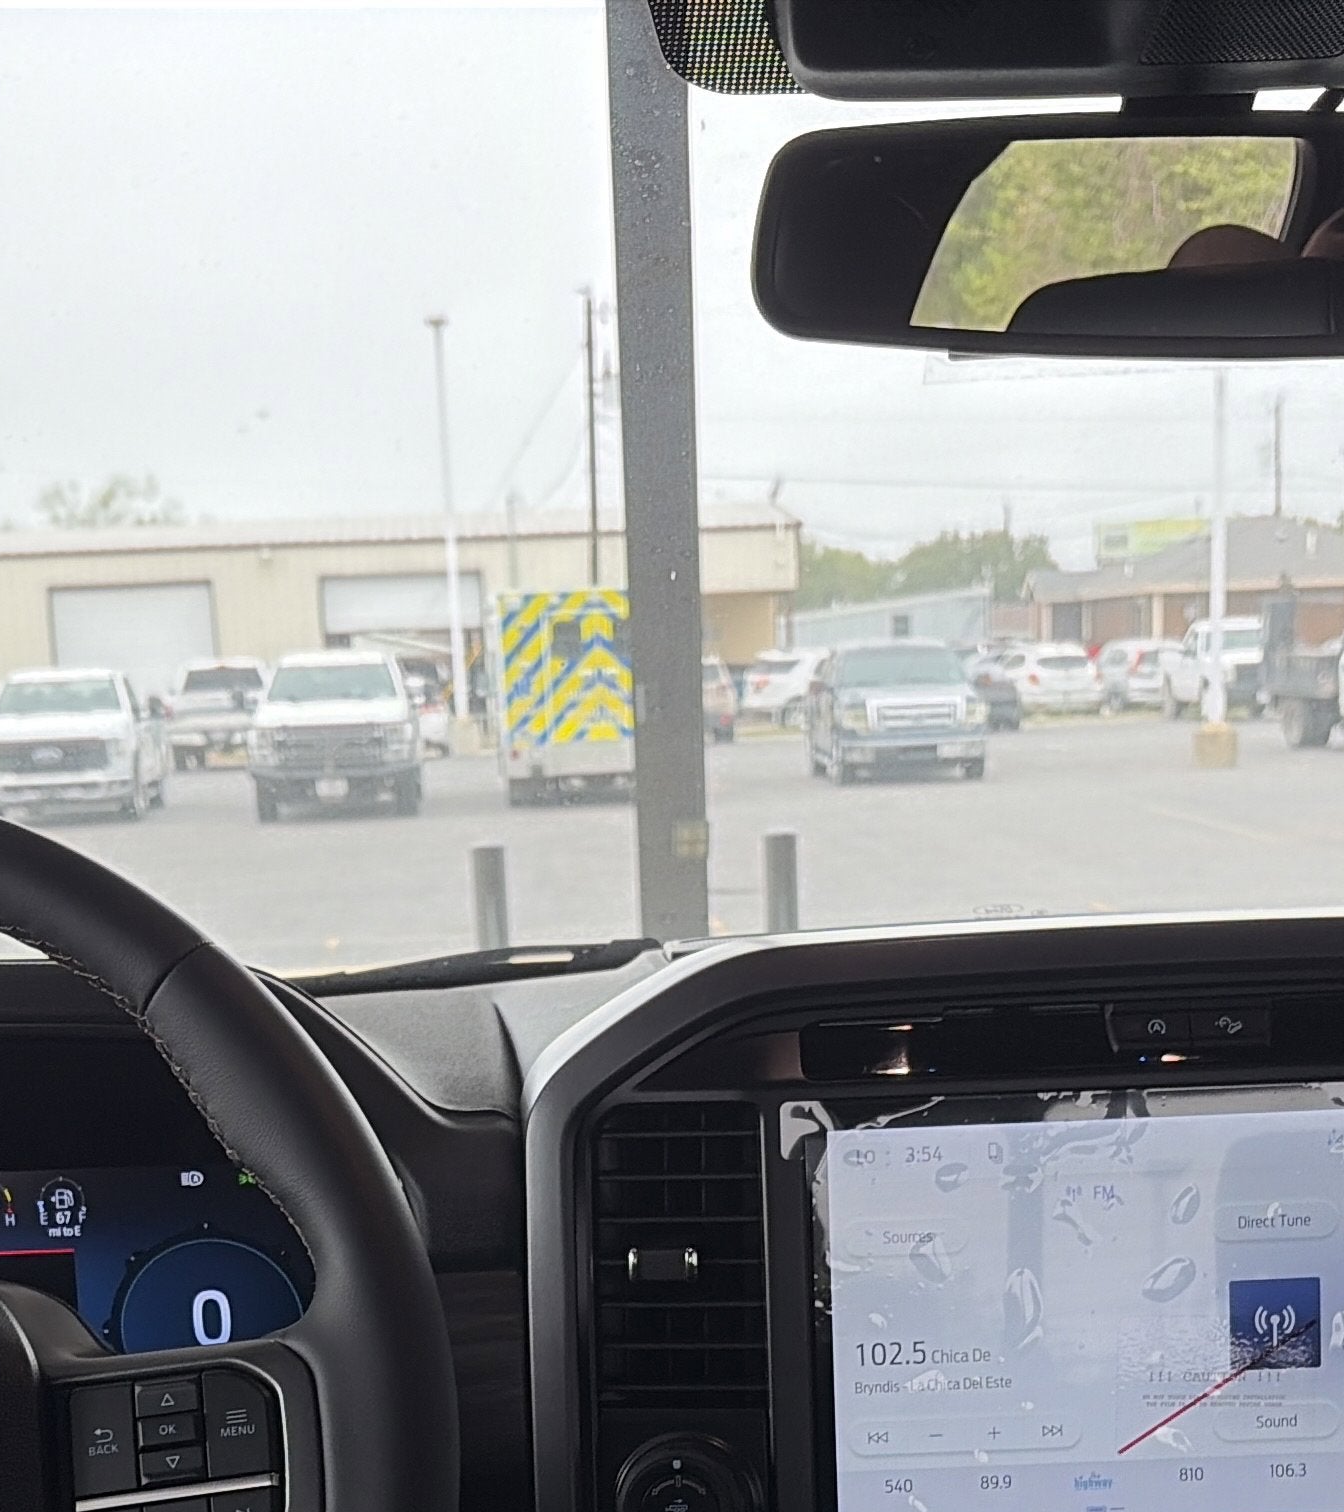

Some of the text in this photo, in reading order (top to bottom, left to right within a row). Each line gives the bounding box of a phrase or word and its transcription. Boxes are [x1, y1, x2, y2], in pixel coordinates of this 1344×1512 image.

[905, 1146, 944, 1163] 3:54
[1093, 1185, 1115, 1199] FM
[56, 1211, 71, 1225] 67
[1238, 1213, 1311, 1229] Direct Tune
[882, 1231, 934, 1244] Sources
[192, 1289, 231, 1346] 0
[856, 1341, 991, 1366] 102.5 Chica De
[854, 1380, 900, 1396] Bryndis
[910, 1380, 925, 1391] La
[927, 1378, 960, 1391] Chica
[963, 1376, 983, 1389] Del
[986, 1376, 1012, 1389] Este
[1256, 1414, 1298, 1429] Sound
[159, 1424, 176, 1435] OK
[221, 1424, 256, 1437] MENU
[88, 1444, 119, 1457] BACK
[1179, 1467, 1204, 1481] 810
[1270, 1463, 1307, 1478] 106.3
[884, 1479, 913, 1494] 540
[980, 1475, 1012, 1489] 89.9
